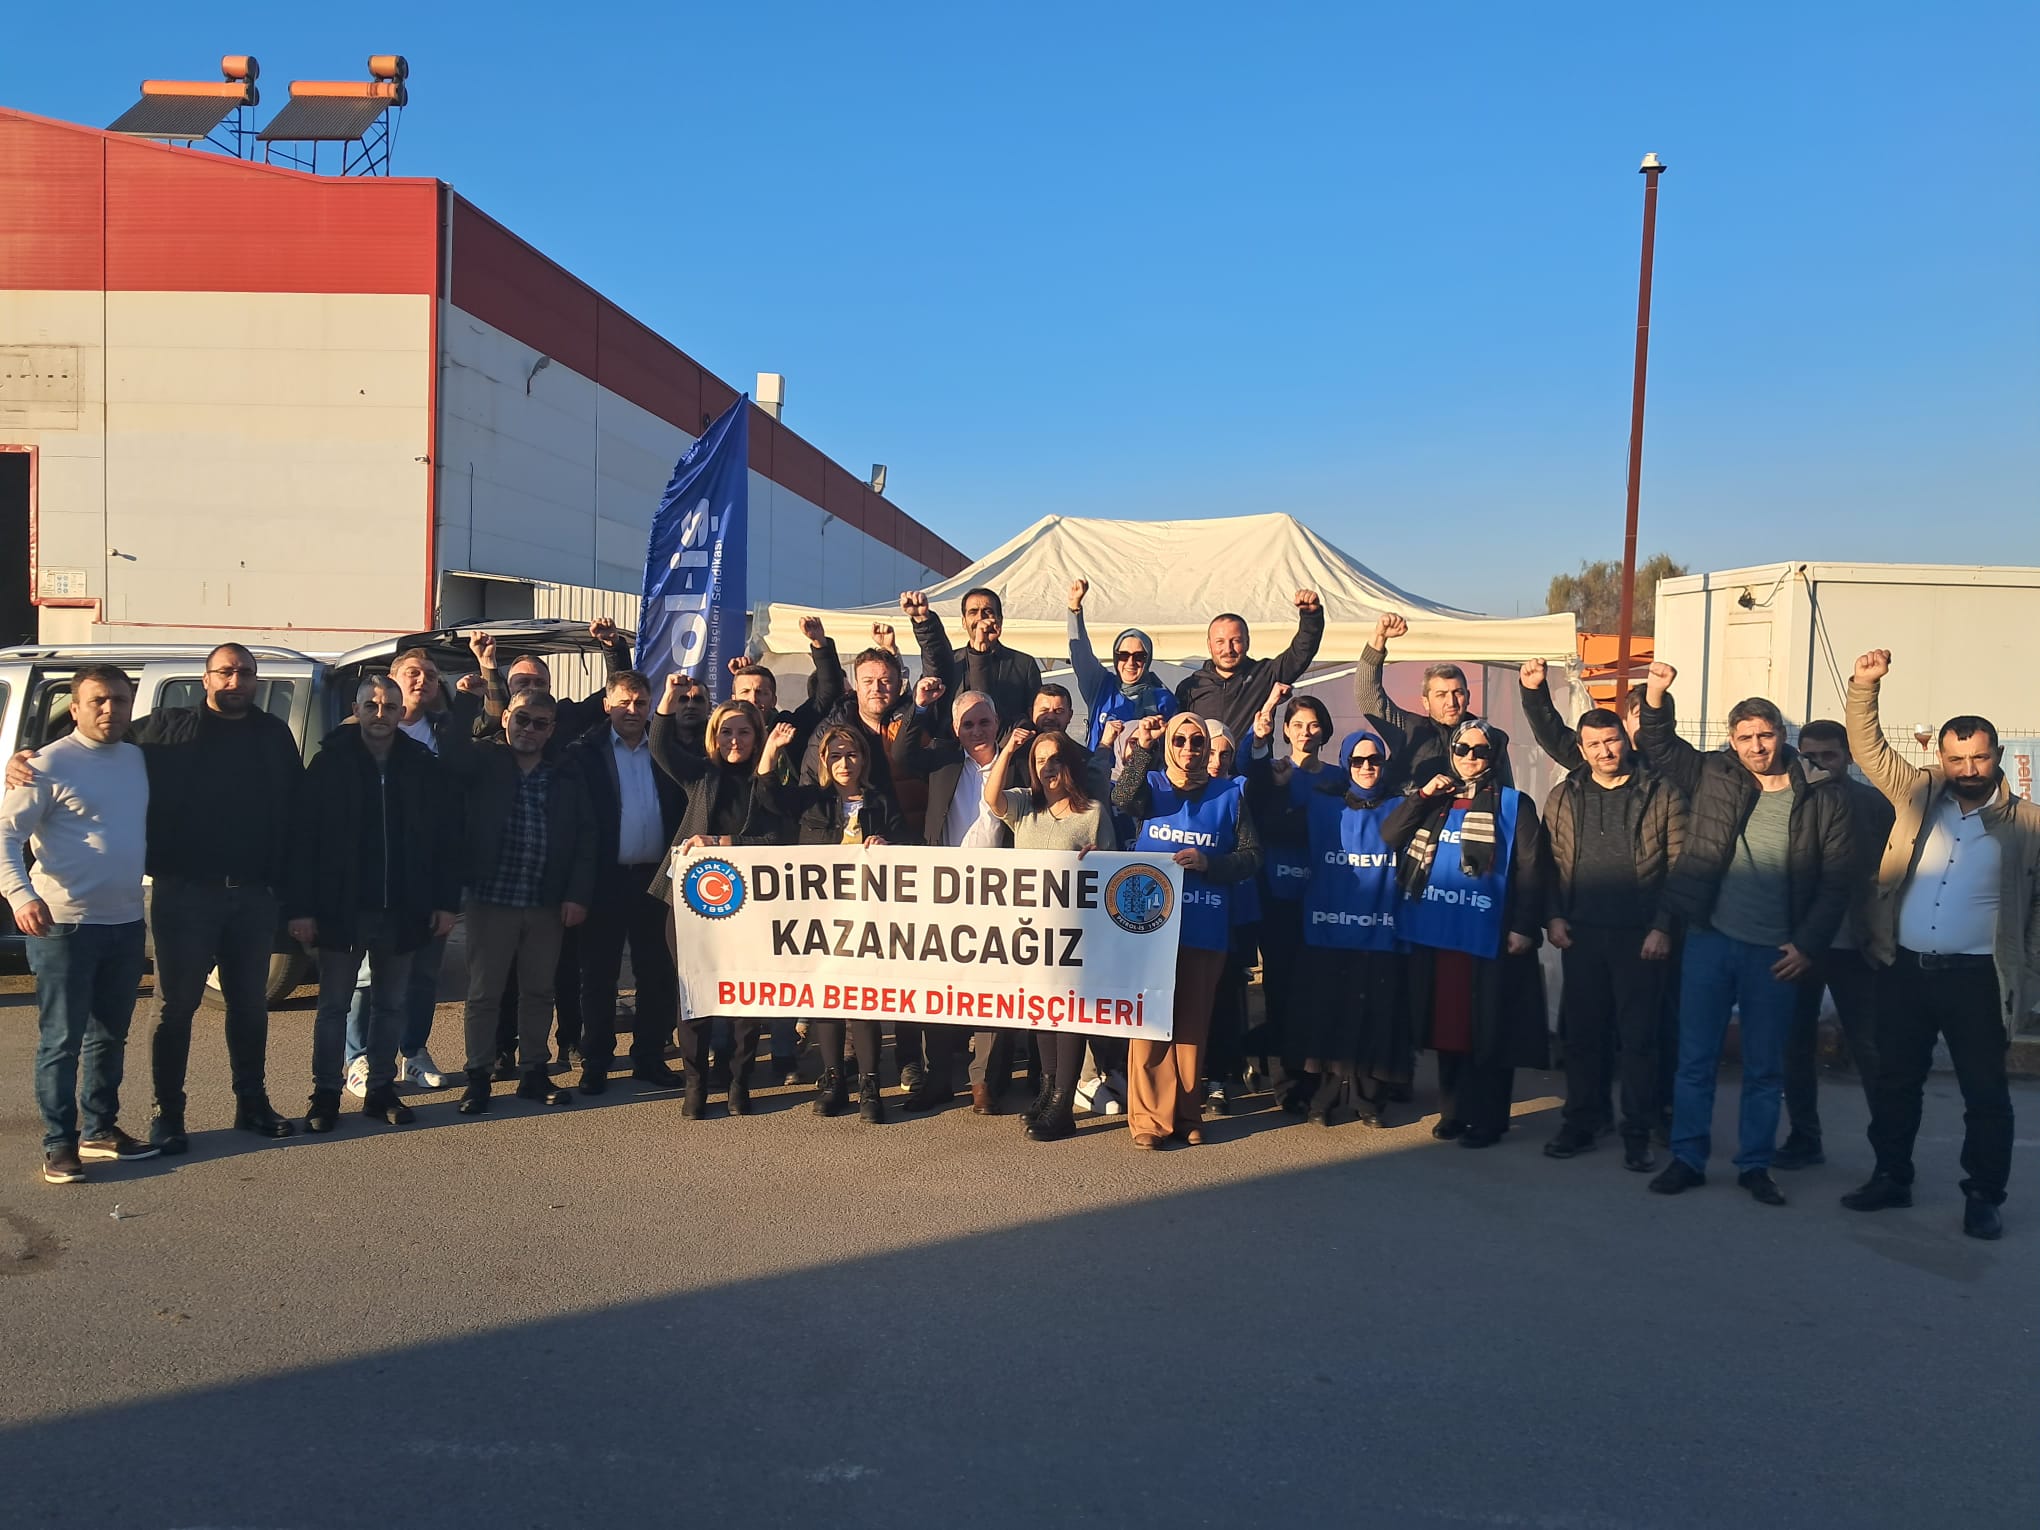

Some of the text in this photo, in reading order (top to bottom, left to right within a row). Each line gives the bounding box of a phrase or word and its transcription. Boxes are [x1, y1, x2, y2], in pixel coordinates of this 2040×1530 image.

[665, 498, 718, 674] ol-iş
[711, 539, 723, 601] Sendikası
[1182, 890, 1222, 908] ol-iş
[772, 917, 1084, 967] KAZANACAĞIZ
[718, 981, 1144, 1027] BURDA BEBEK DİRENİŞÇİLERİ
